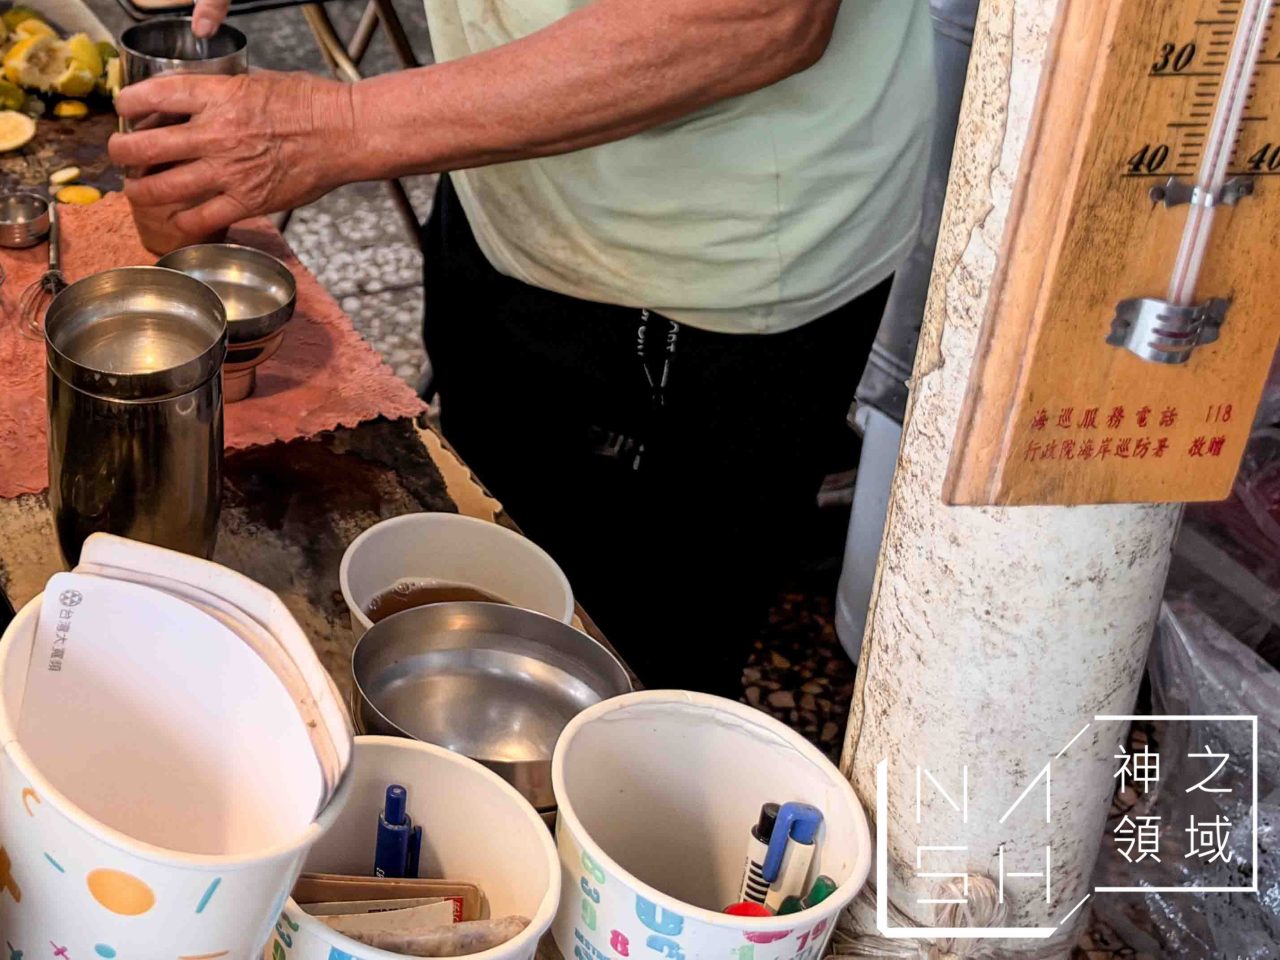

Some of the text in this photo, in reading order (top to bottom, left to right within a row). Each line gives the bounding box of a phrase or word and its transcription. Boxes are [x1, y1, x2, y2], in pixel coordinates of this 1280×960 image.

[1151, 42, 1196, 73] 30
[1126, 144, 1169, 173] 40
[1030, 404, 1233, 429] 海巡服務電話 118
[1023, 438, 1169, 462] 行政院海岸巡防署
